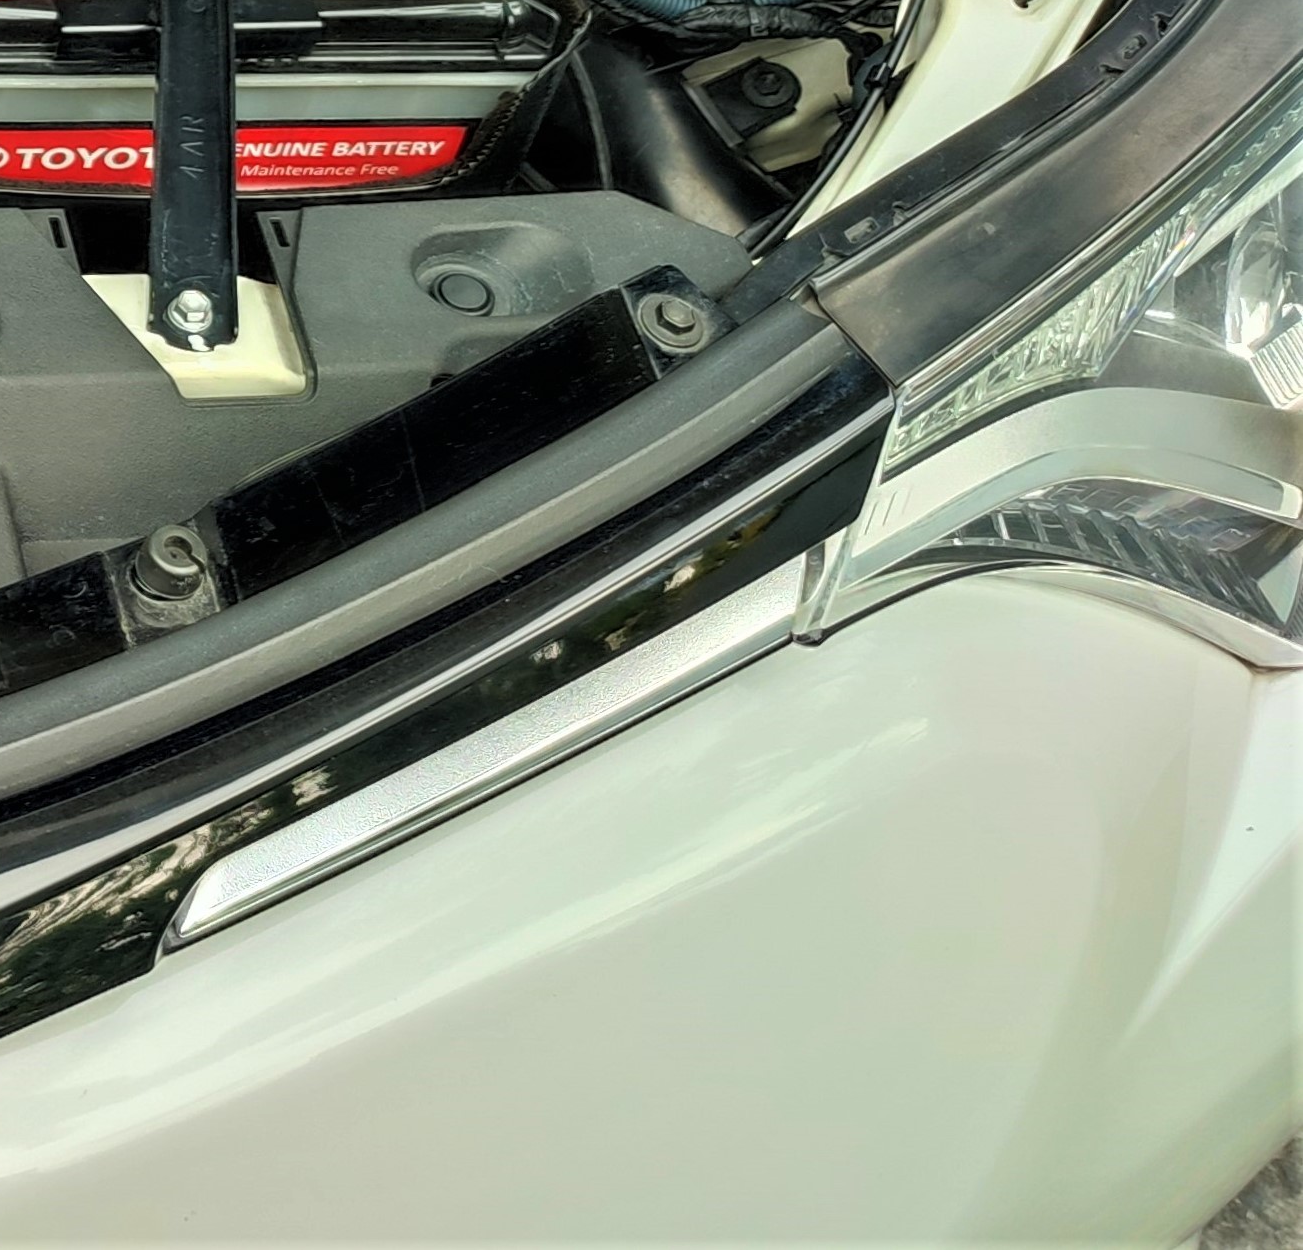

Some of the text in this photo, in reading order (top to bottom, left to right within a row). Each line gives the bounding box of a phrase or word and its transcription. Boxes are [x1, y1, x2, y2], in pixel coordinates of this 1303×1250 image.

[15, 146, 154, 170] TOYOT
[235, 140, 446, 158] ENUINE BATTERY
[240, 163, 399, 177] Maintenance Free
